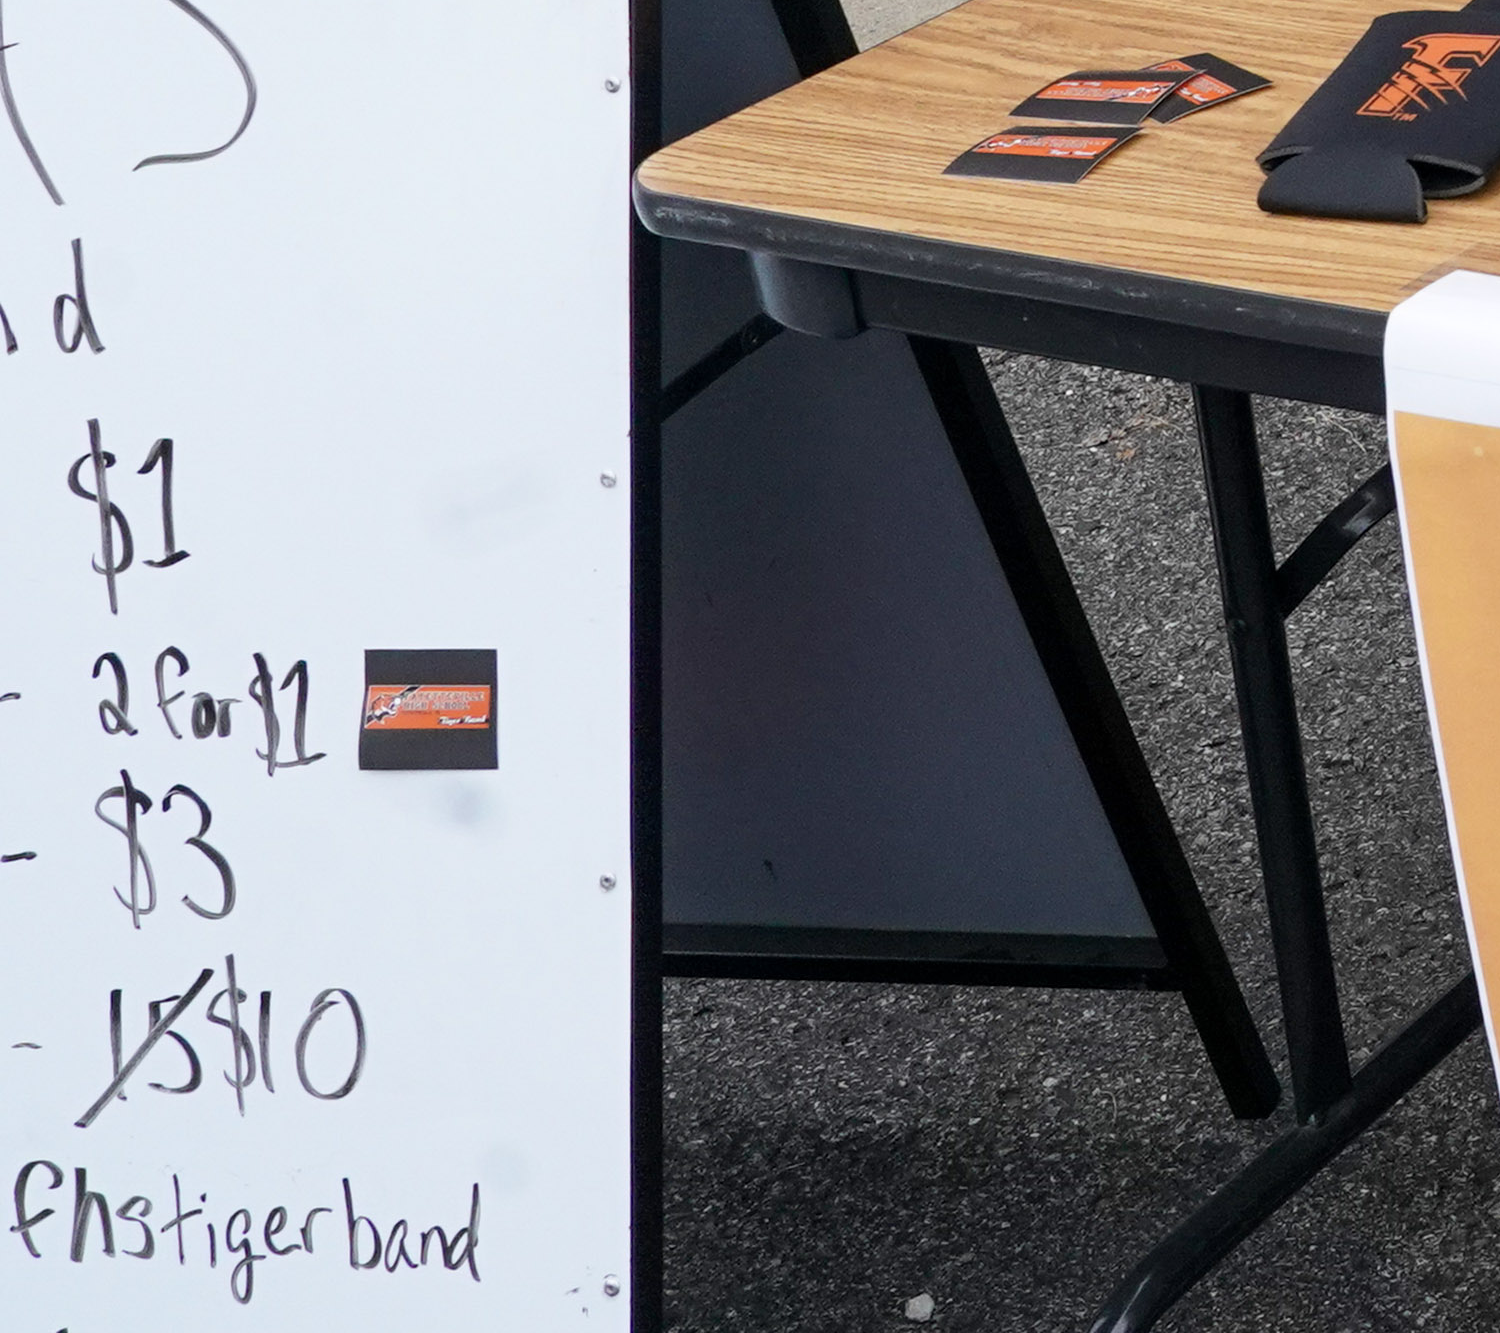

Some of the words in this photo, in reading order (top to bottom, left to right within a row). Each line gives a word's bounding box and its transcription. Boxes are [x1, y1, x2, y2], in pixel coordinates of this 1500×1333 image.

[68, 419, 191, 615] $1
[93, 652, 136, 737] 2
[153, 646, 241, 740] for
[250, 652, 328, 777] $1
[94, 770, 236, 930] $3
